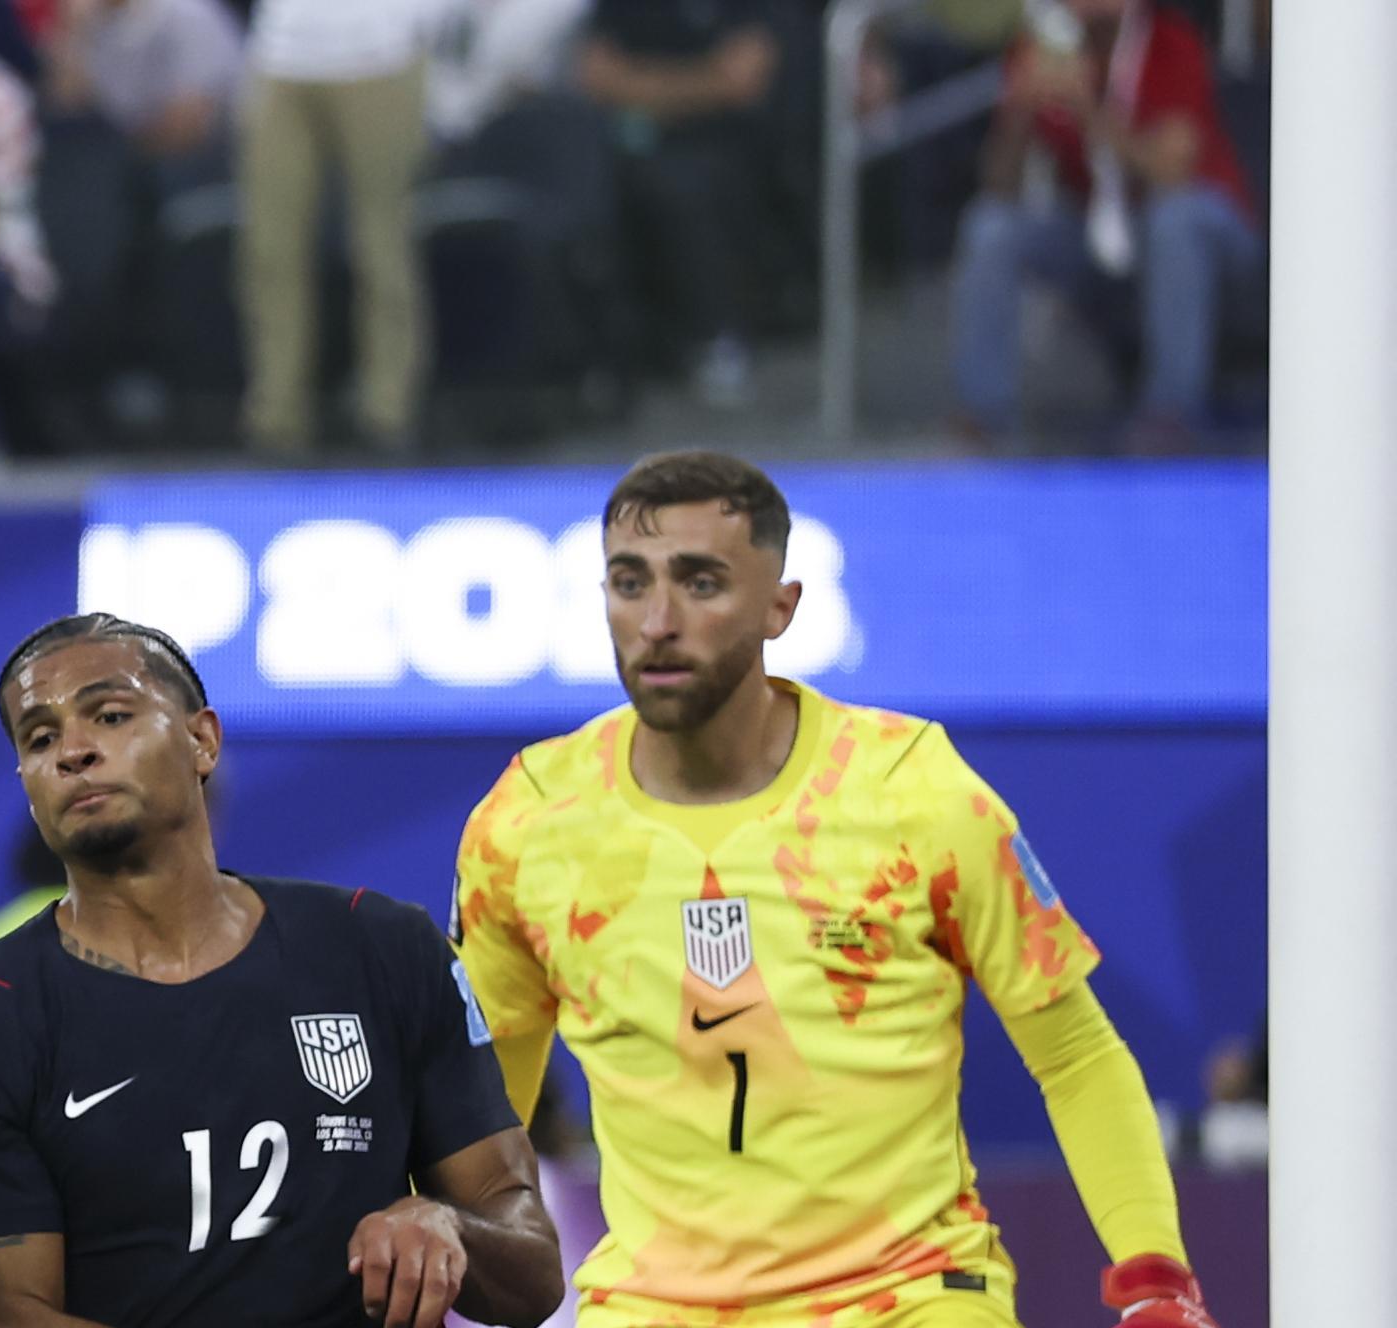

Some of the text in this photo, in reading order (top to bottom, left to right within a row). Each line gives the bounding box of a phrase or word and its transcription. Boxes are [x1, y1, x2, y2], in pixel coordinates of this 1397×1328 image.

[687, 904, 743, 937] USA
[298, 1019, 360, 1053] USA
[725, 1050, 748, 1154] 1
[182, 1119, 289, 1253] 12
